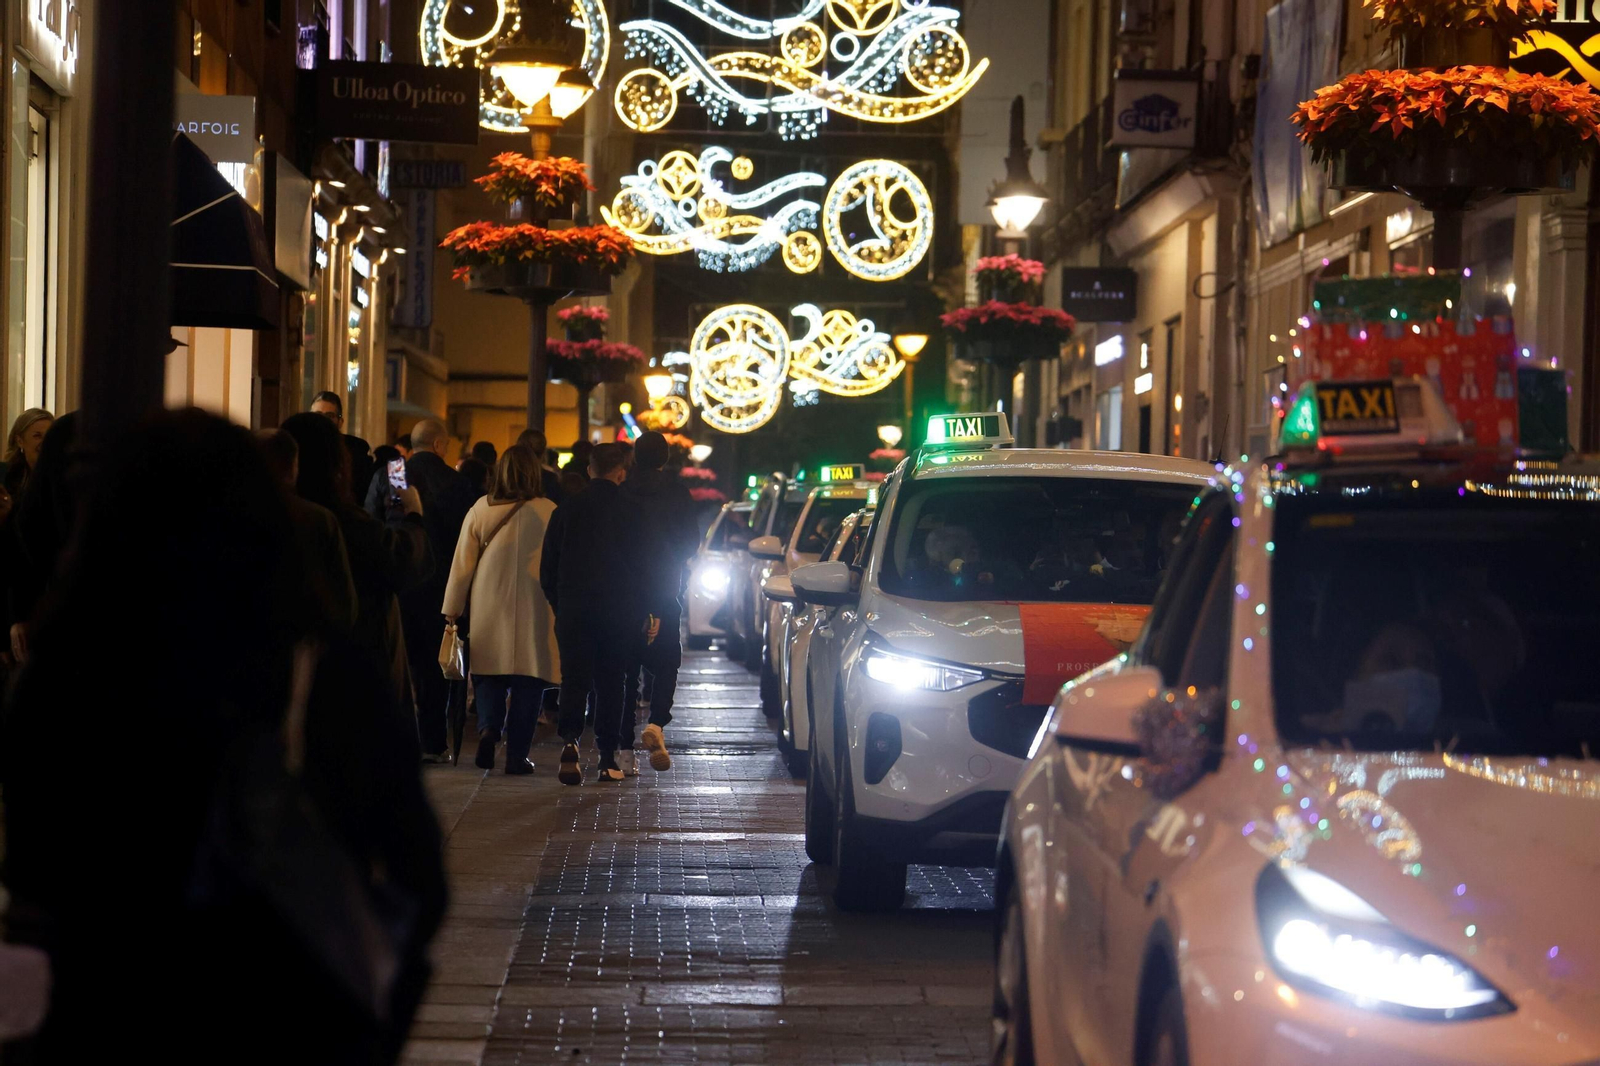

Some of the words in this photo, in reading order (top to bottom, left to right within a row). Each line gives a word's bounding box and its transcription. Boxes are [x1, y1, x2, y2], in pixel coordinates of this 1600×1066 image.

[332, 77, 390, 101] Ulloa
[393, 80, 466, 109] Optico
[173, 122, 239, 135] ARFOIS
[1318, 388, 1396, 419] TAXI
[946, 418, 982, 437] TAXI
[830, 466, 853, 480] TAXI
